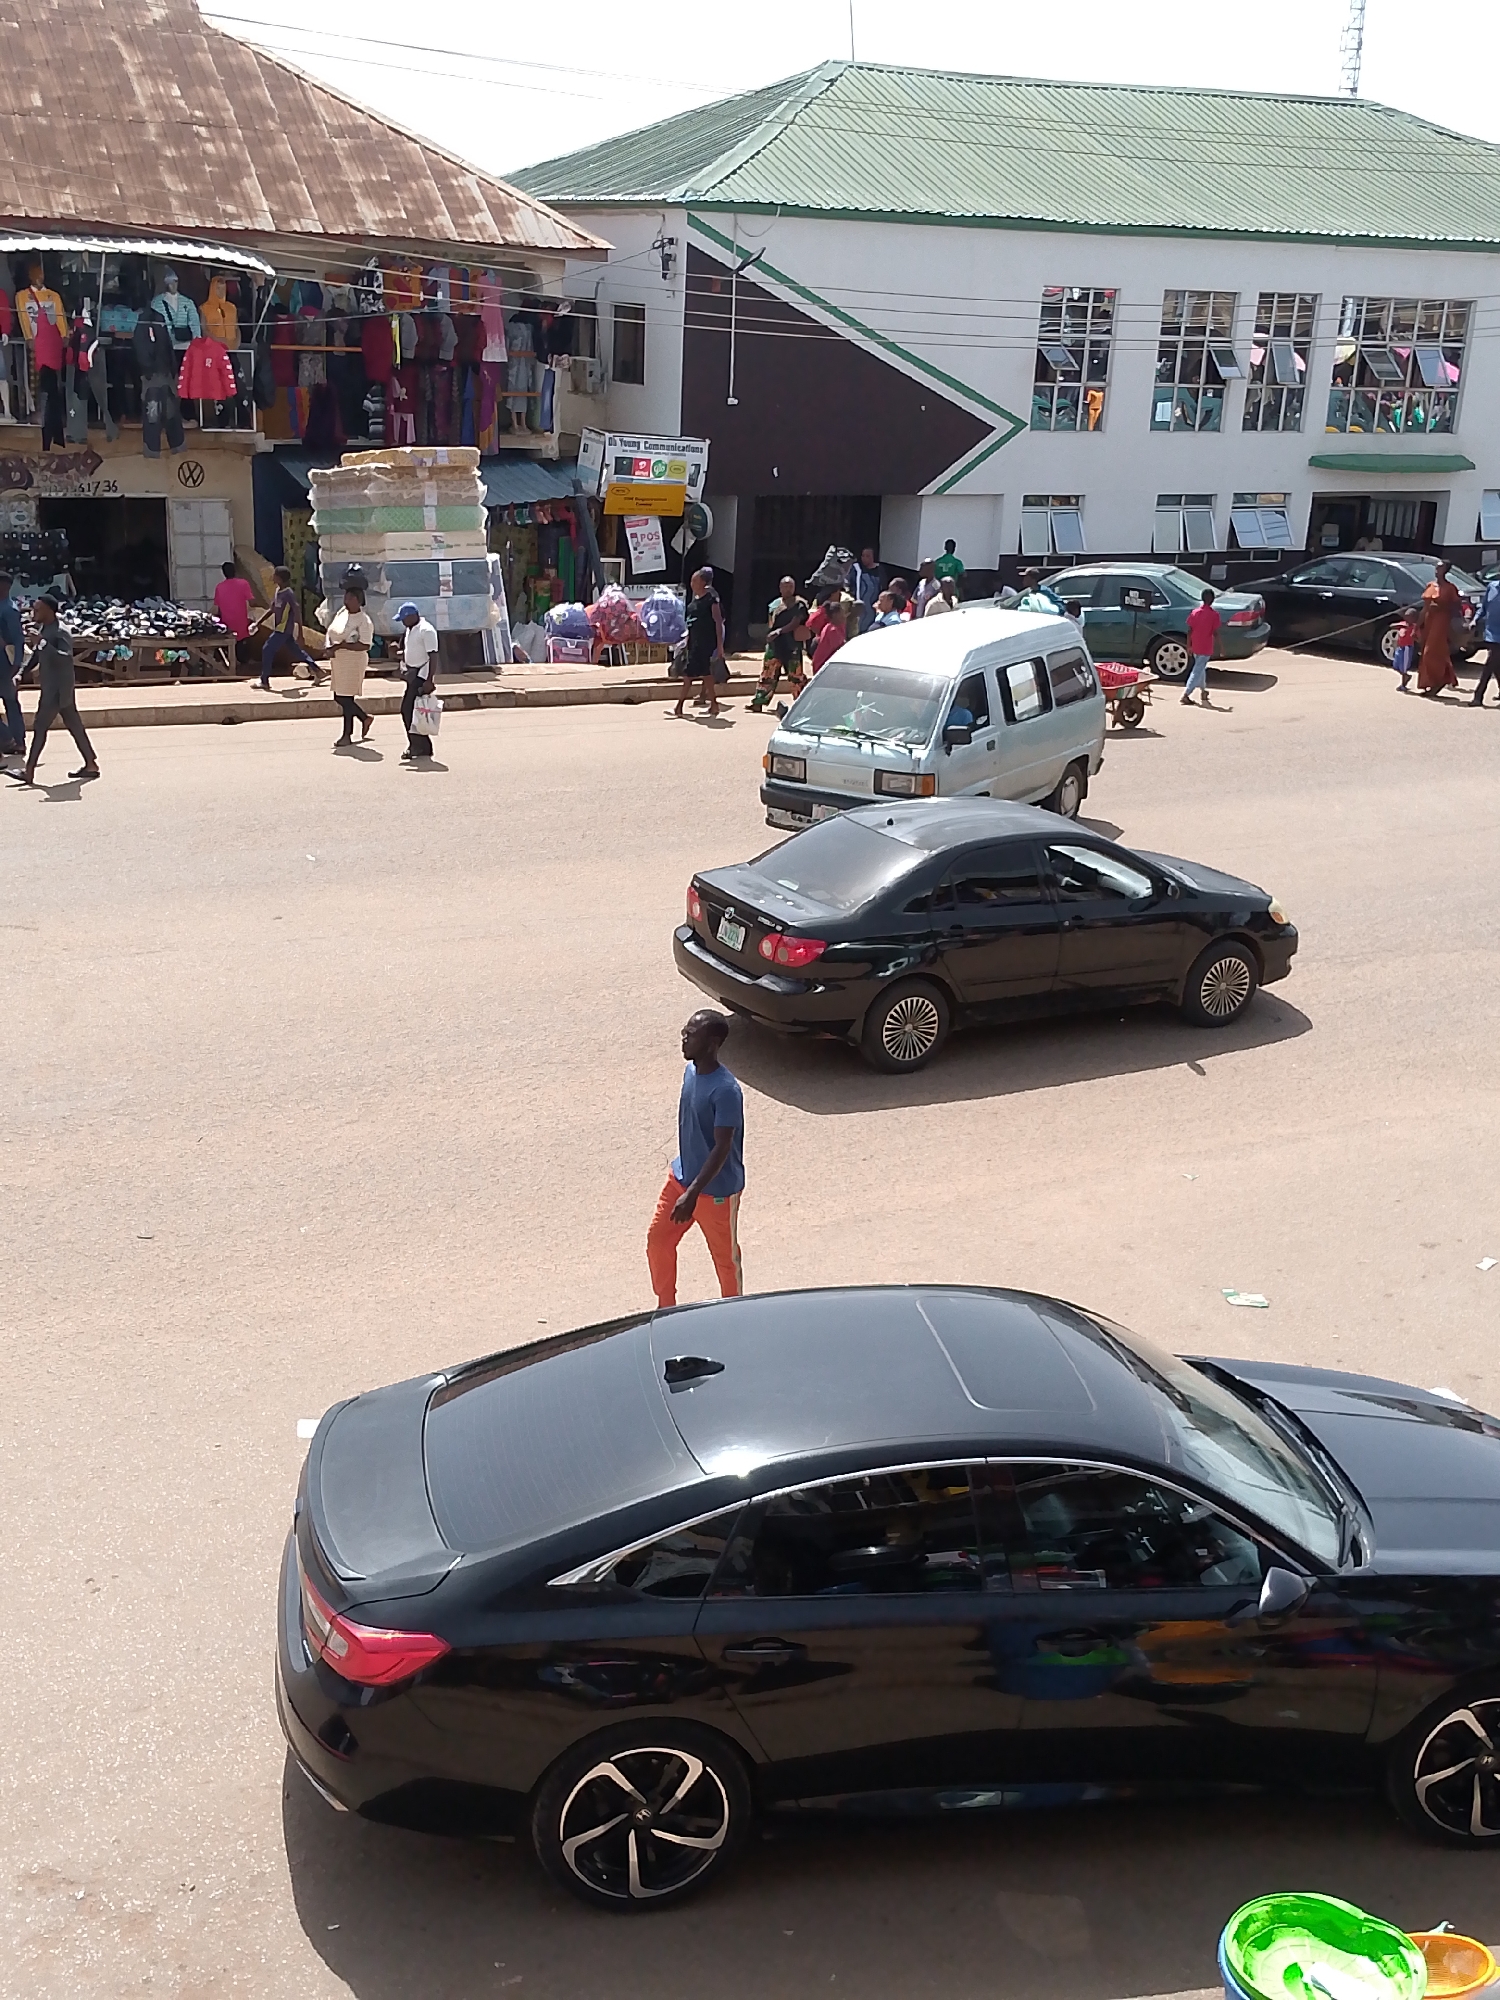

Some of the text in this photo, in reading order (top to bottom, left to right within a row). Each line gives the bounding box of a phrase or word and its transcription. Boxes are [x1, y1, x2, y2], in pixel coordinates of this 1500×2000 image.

[619, 438, 641, 451] Young
[644, 440, 703, 454] Communications
[653, 463, 666, 476] glo
[640, 532, 660, 542] POS
